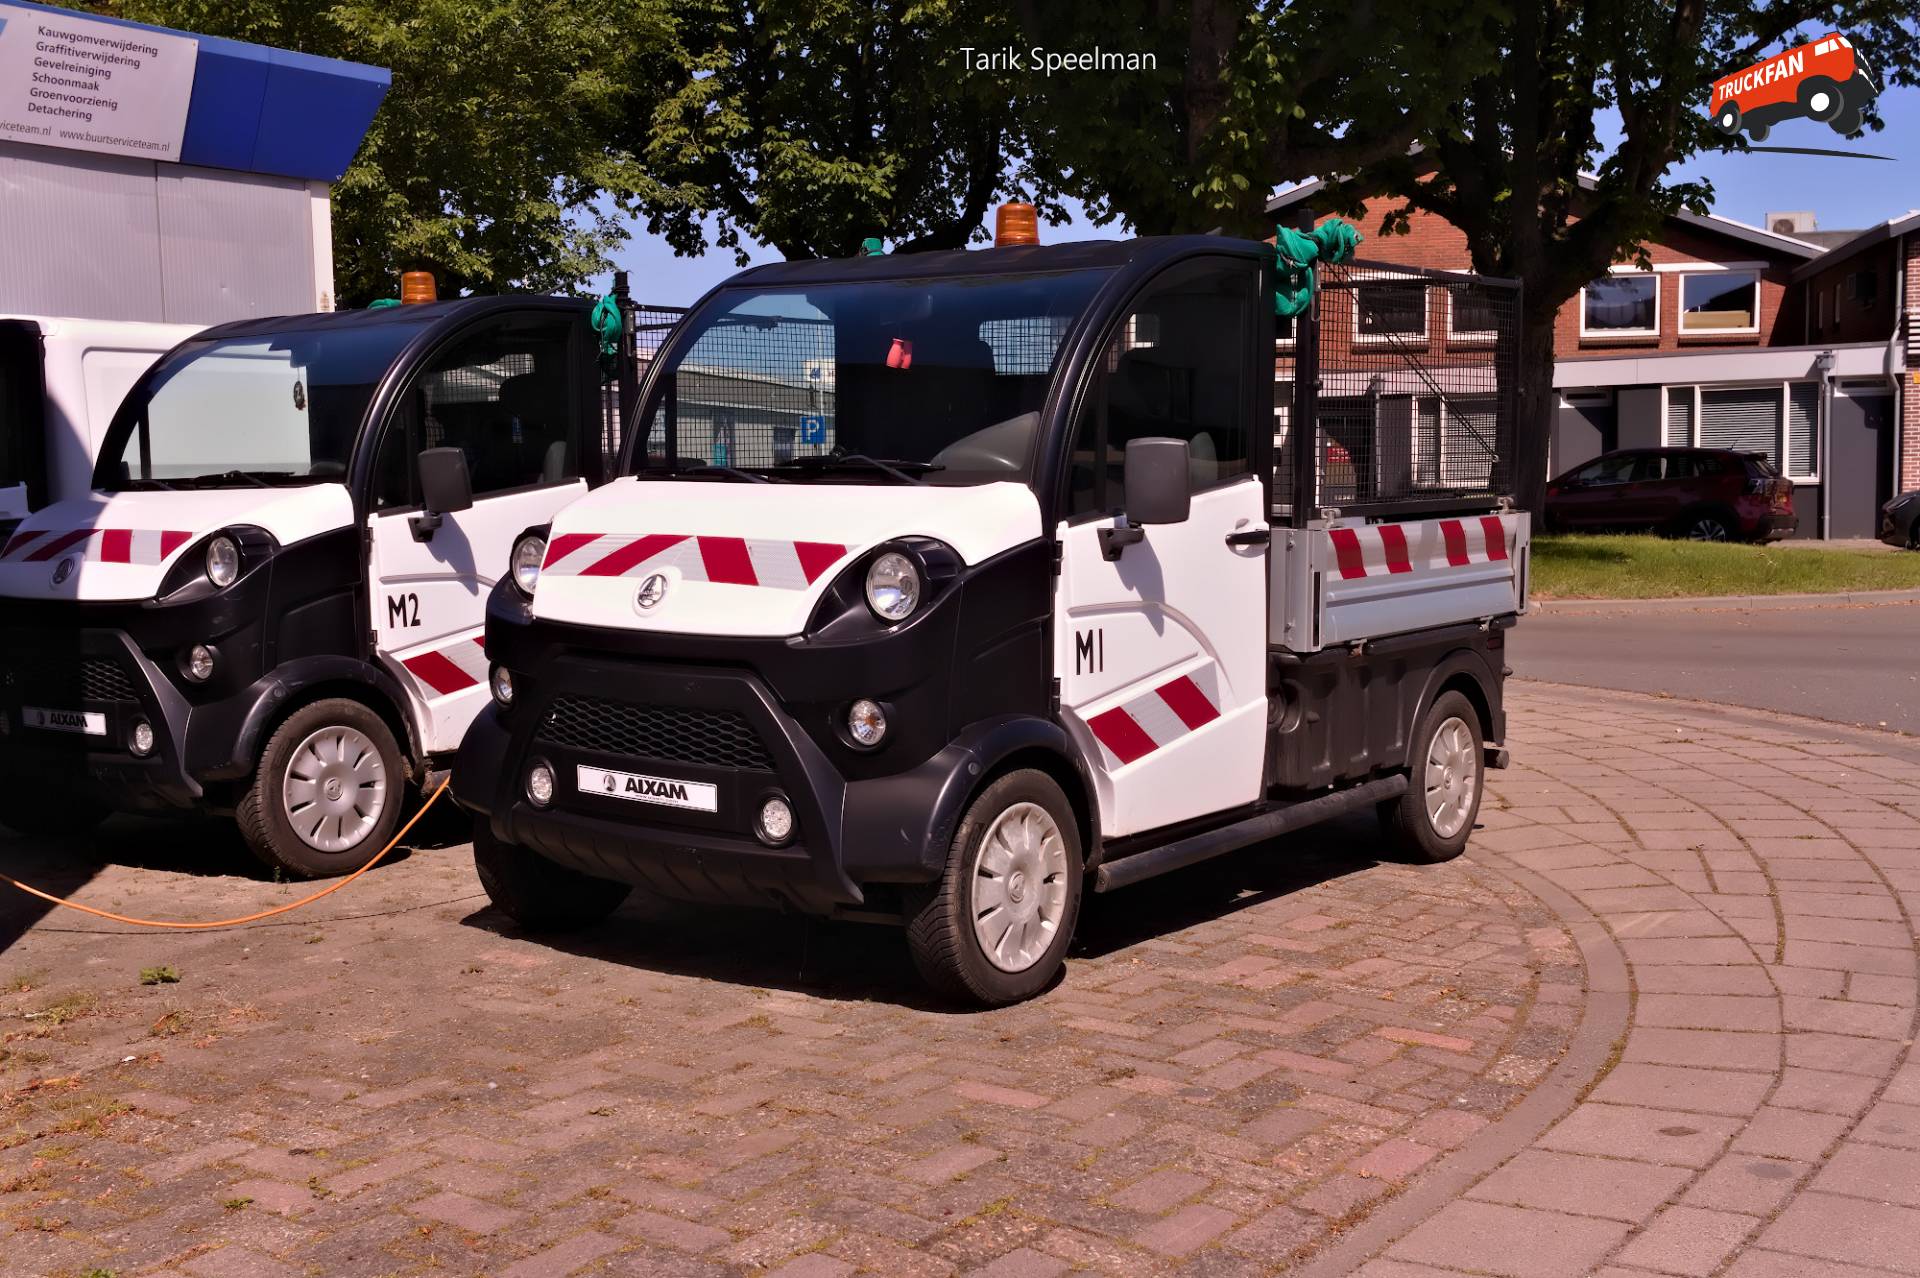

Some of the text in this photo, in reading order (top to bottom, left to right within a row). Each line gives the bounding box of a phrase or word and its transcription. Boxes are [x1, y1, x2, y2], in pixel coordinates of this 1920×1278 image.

[37, 25, 159, 57] Kauwgomverwijdering
[35, 41, 141, 70] Graffitiverwijdering
[33, 56, 112, 80] Gevelreiniging
[31, 72, 101, 92] Schoonmaak
[27, 102, 93, 123] Detachering
[59, 129, 171, 152] www.buurtserviceteam.nl
[387, 592, 422, 629] M2
[50, 711, 88, 728] AIXAM
[625, 777, 689, 801] AIXAM
